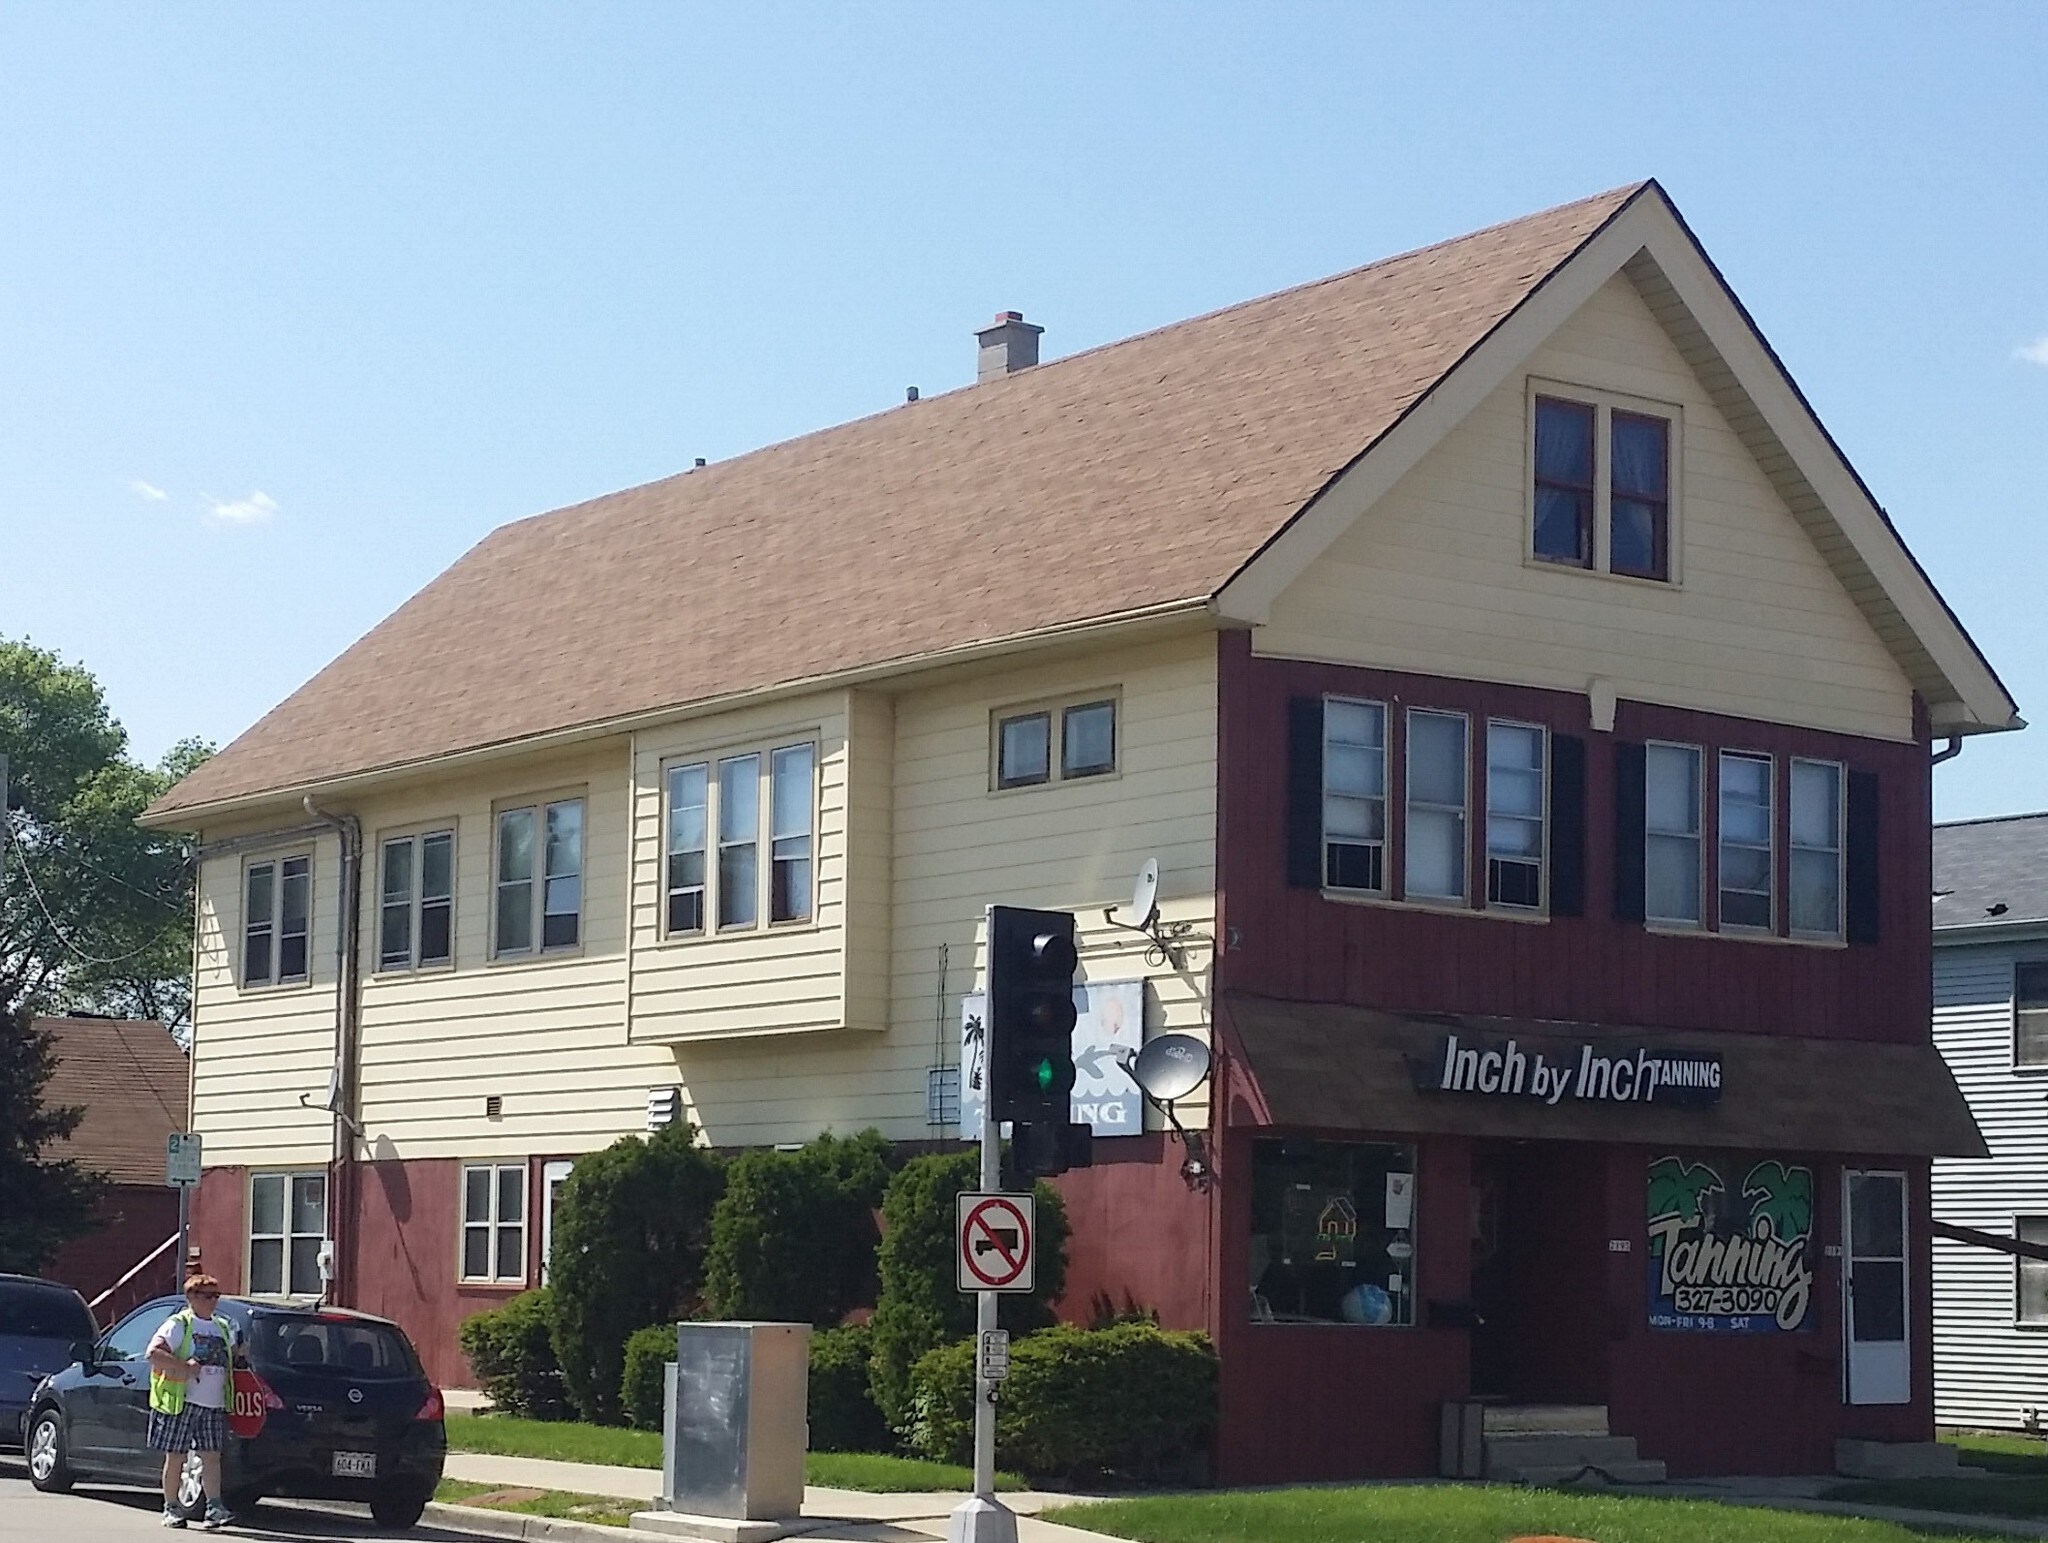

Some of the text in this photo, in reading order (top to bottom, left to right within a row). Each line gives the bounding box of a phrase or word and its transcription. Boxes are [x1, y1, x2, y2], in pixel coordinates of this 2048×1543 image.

[1439, 1035, 1721, 1105] Inch by Inch TANNING
[1649, 1214, 1813, 1329] Tanning
[1677, 1289, 1777, 1312] 327-3090
[1730, 1317, 1750, 1329] SAT
[231, 1391, 263, 1417] STO
